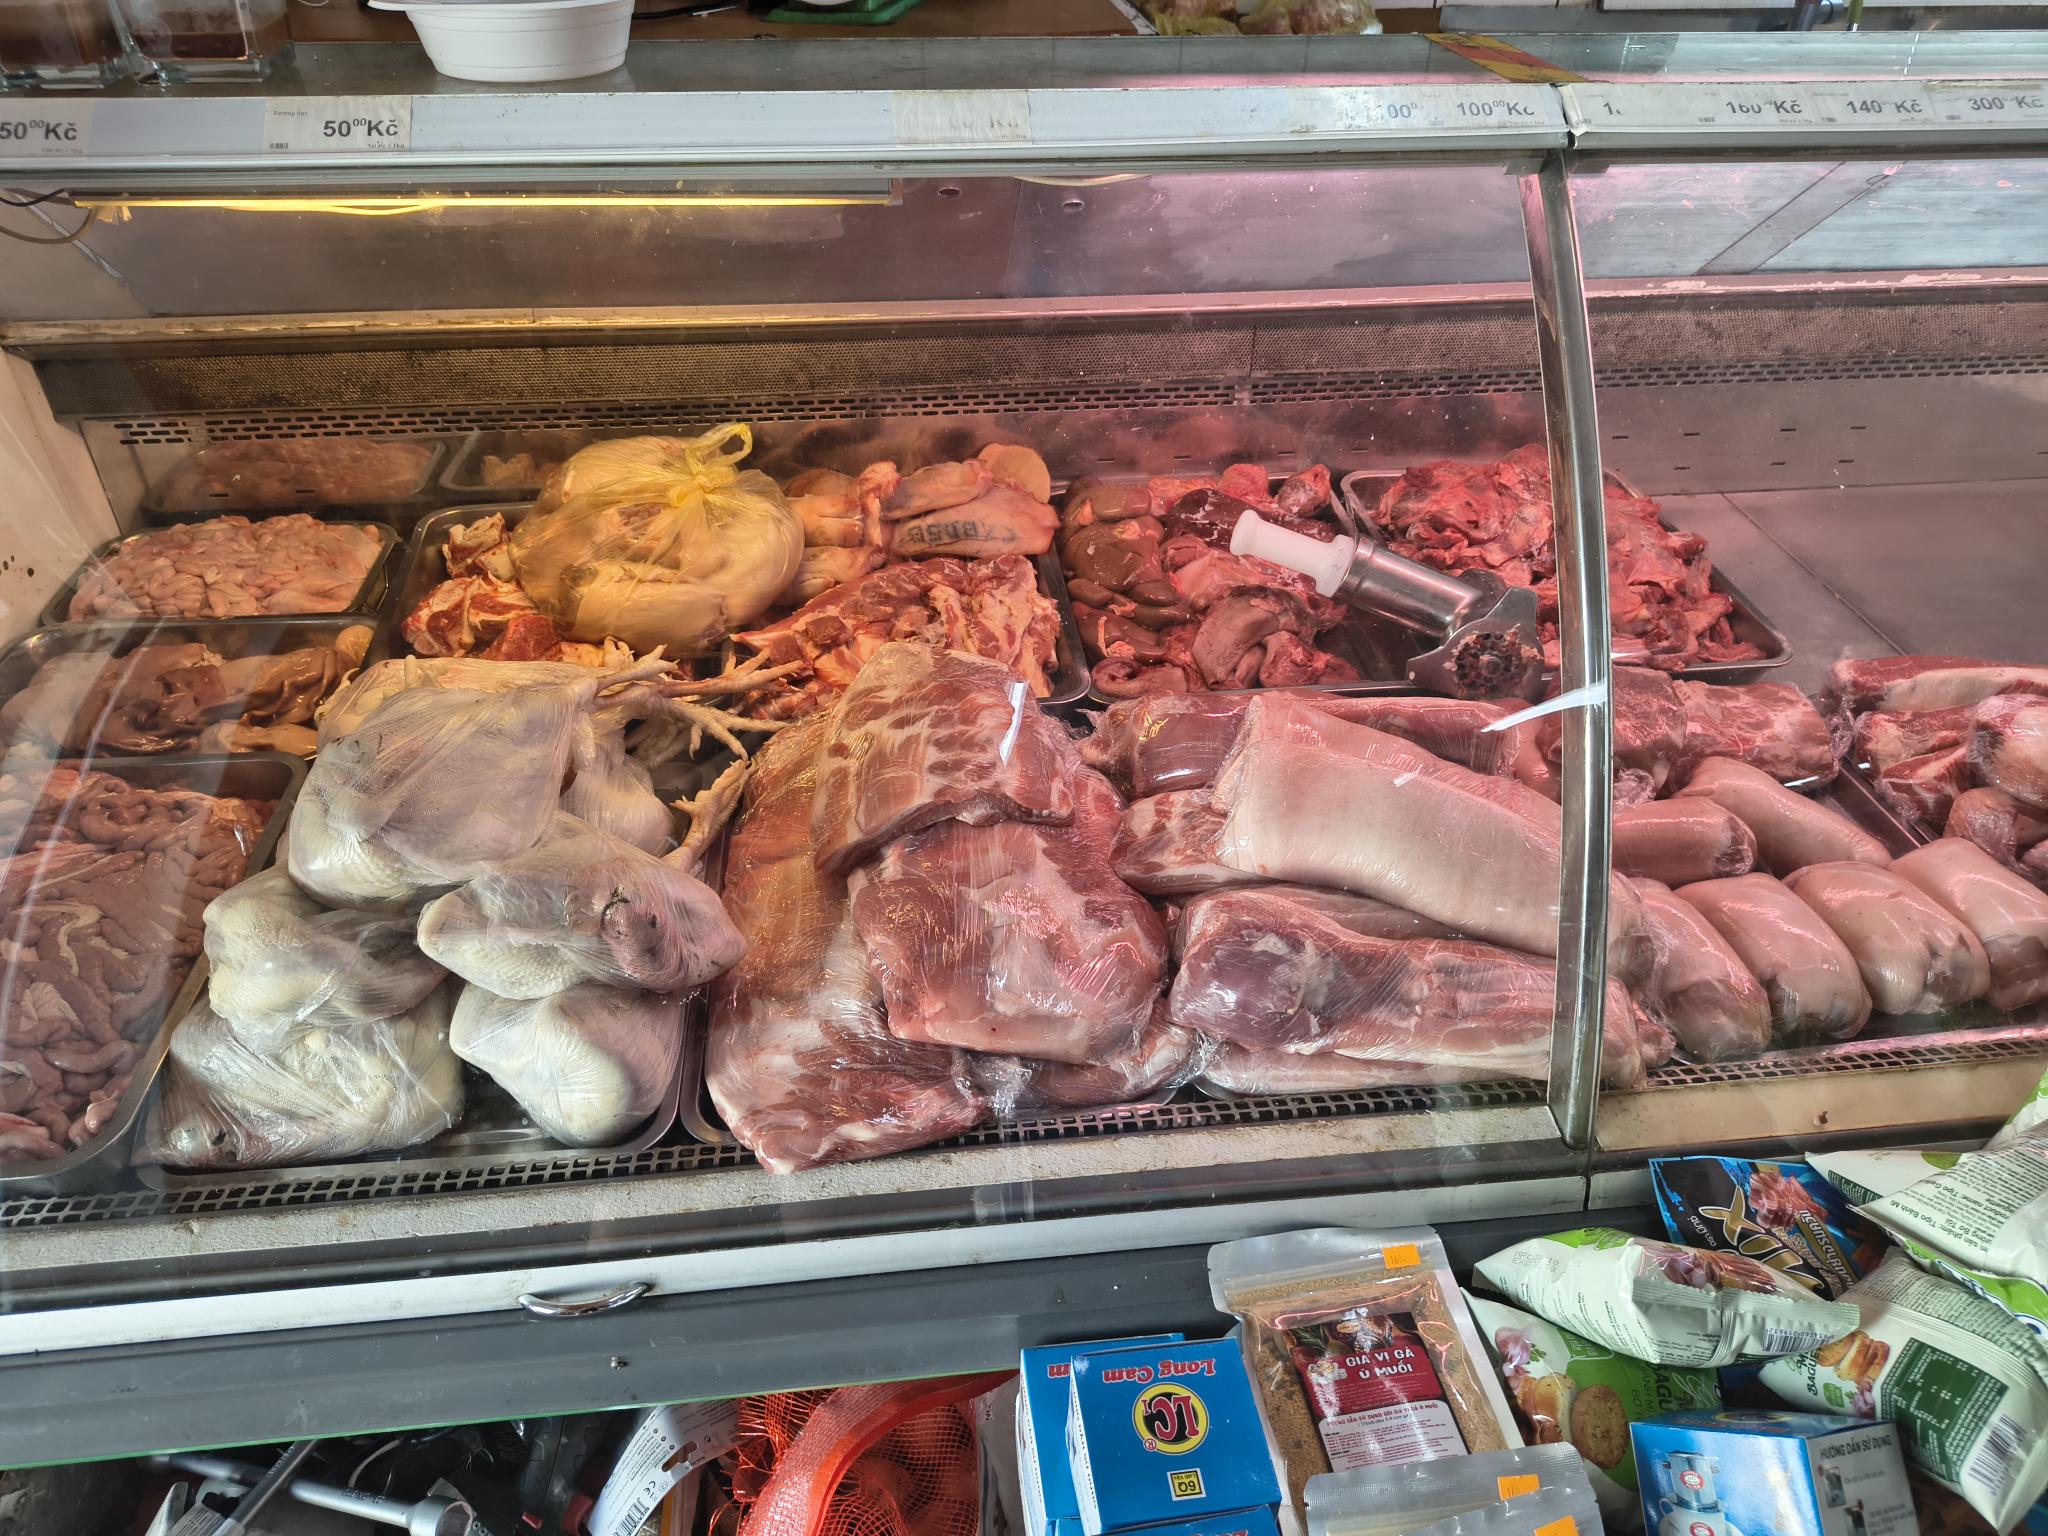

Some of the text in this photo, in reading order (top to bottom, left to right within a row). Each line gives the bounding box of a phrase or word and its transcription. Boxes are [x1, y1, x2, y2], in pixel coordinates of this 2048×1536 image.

[1374, 1351, 1390, 1363] VỊ
[1102, 1359, 1216, 1384] Long Cam
[1374, 1360, 1413, 1377] MUỐI
